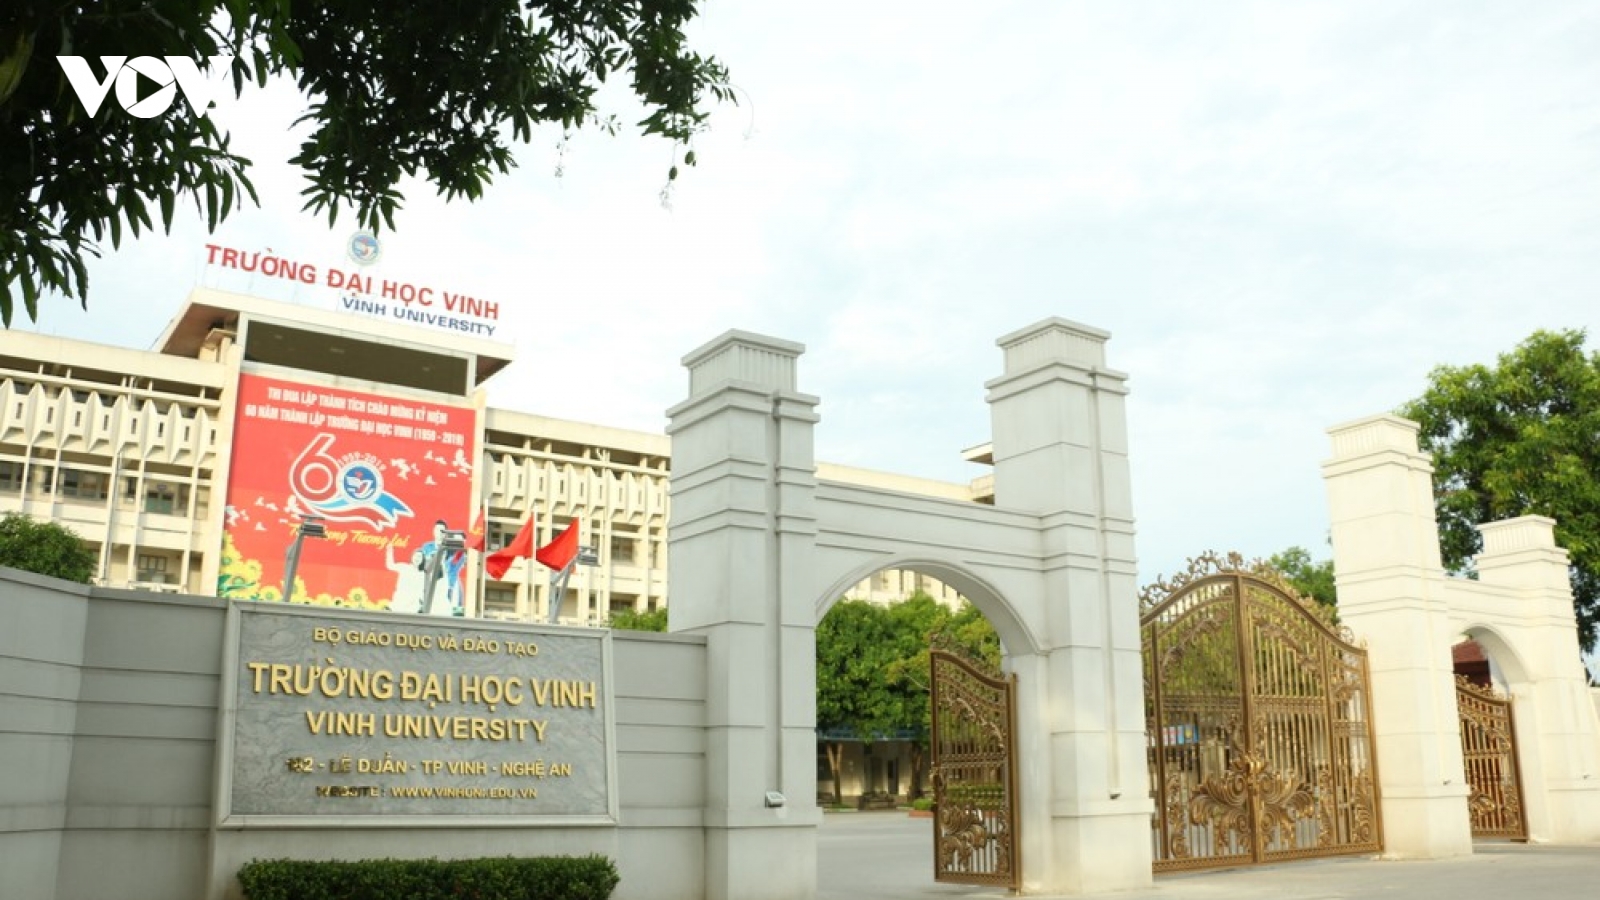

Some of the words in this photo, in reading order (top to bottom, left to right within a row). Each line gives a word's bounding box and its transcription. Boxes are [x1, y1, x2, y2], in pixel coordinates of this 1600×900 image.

[205, 244, 316, 284] TRƯỜNG
[327, 268, 372, 297] ĐẠI
[382, 279, 433, 307] HỌC
[444, 291, 499, 320] VINH
[343, 296, 386, 316] VINH
[393, 305, 496, 335] UNIVERSITY
[313, 626, 342, 646] BỘ
[345, 628, 391, 646] GIÁO
[395, 633, 432, 652] DỤC
[437, 633, 458, 651] VÀ
[463, 635, 500, 654] ĐÀO
[505, 641, 539, 658] TẠO
[248, 659, 393, 699] TRƯỜNG
[400, 670, 452, 708] ĐẠI
[461, 675, 523, 713] HỌC
[529, 679, 596, 709] VINH
[306, 710, 375, 737] VINH
[384, 715, 548, 741] UNIVERSITY
[422, 760, 443, 774] TP
[447, 761, 487, 776] VINH
[501, 759, 545, 779] NGHỆ
[549, 763, 572, 777] AN
